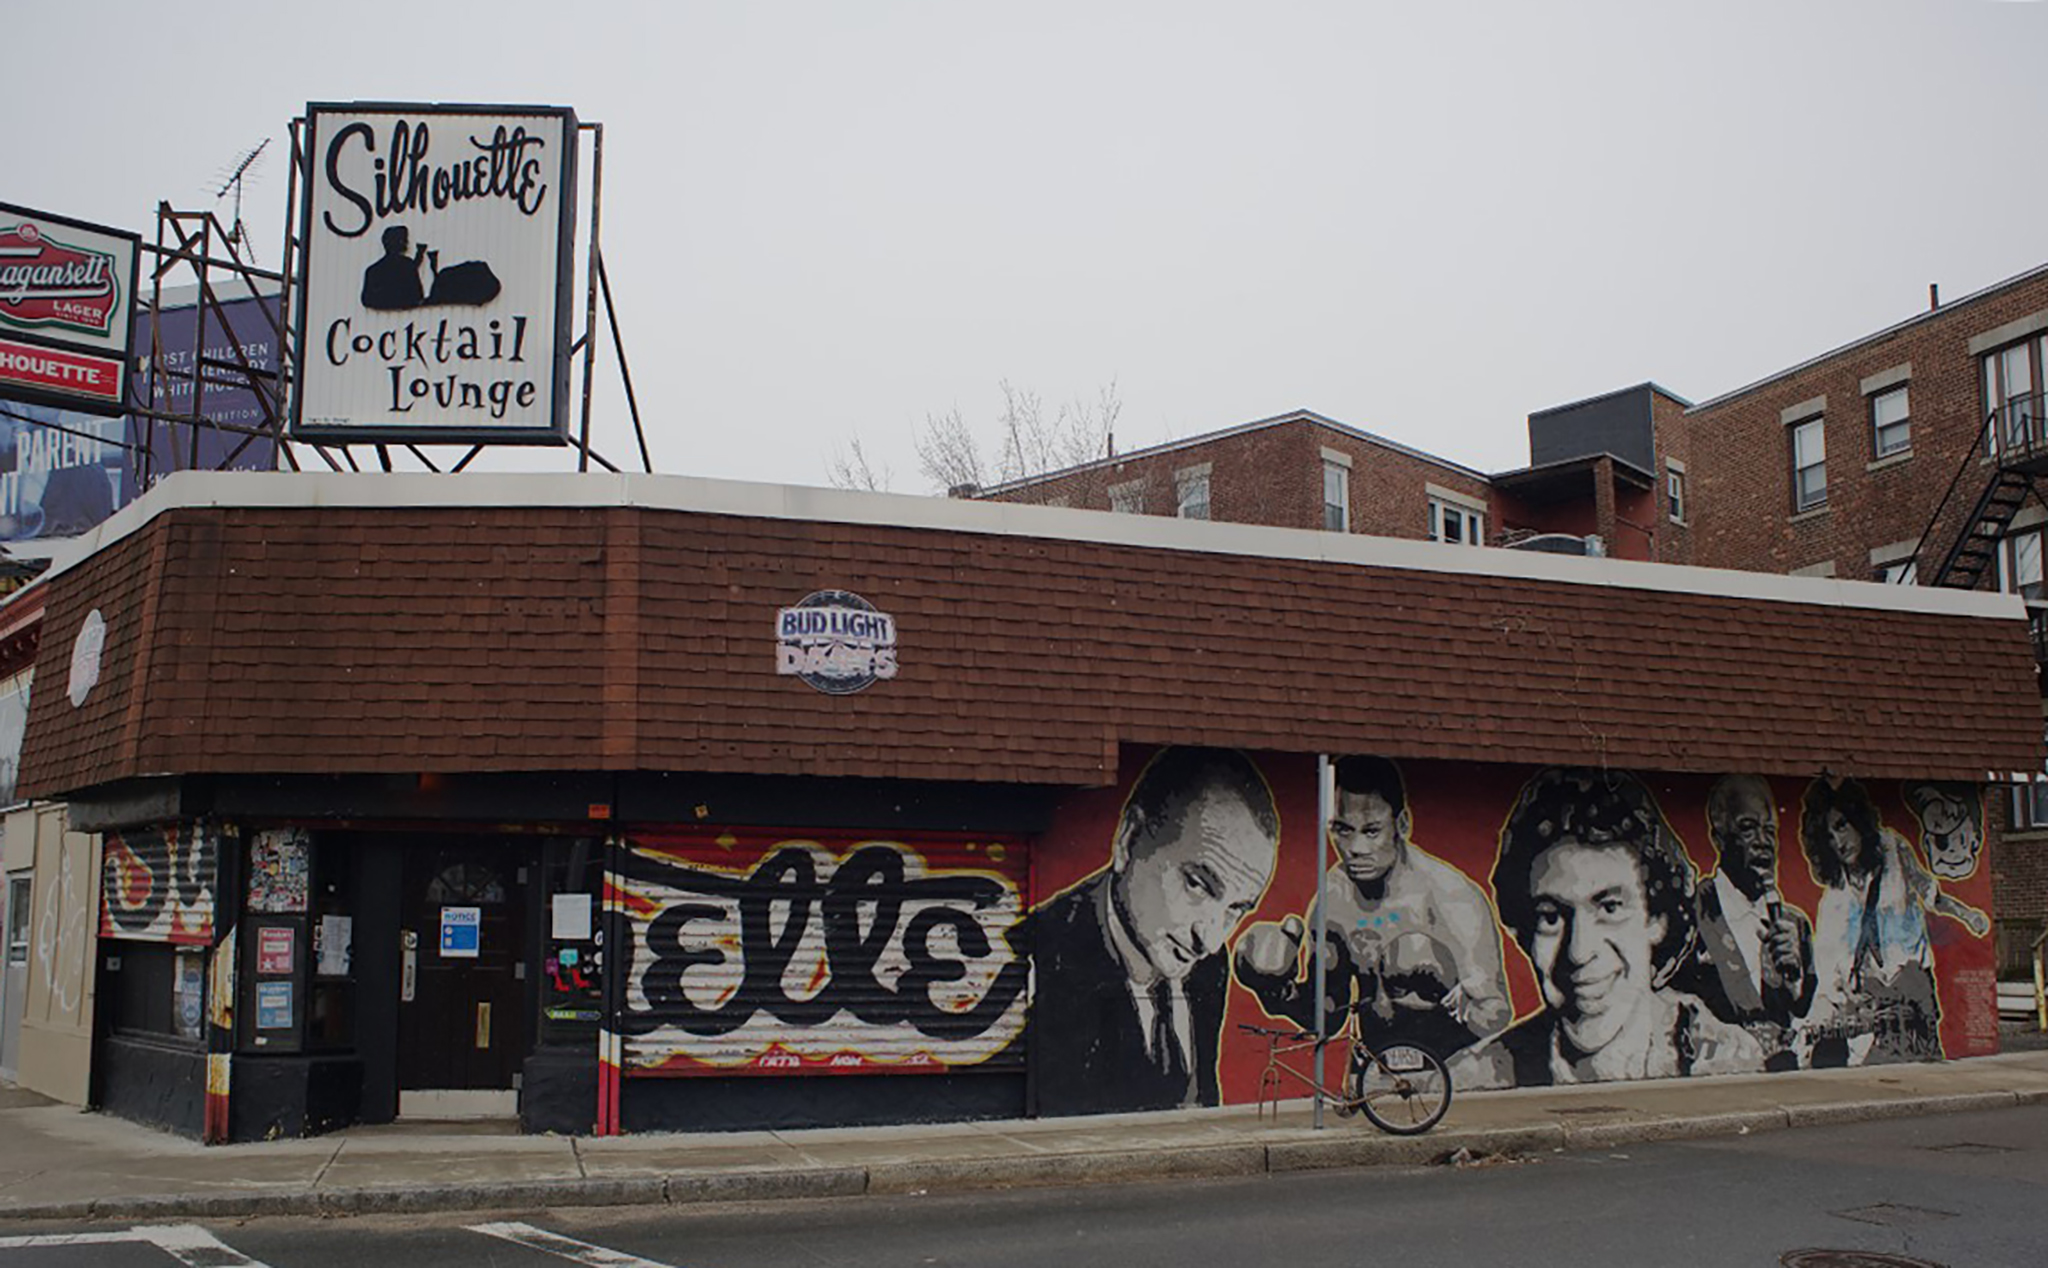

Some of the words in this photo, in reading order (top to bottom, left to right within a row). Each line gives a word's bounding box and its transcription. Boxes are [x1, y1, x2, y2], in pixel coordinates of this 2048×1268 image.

[323, 119, 547, 238] Silhouette
[53, 300, 103, 320] LAGER
[326, 316, 527, 370] Cocktail
[388, 365, 536, 419] Lounge
[17, 421, 102, 475] PARENT
[782, 611, 828, 636] BUD
[830, 612, 888, 641] LIGHT
